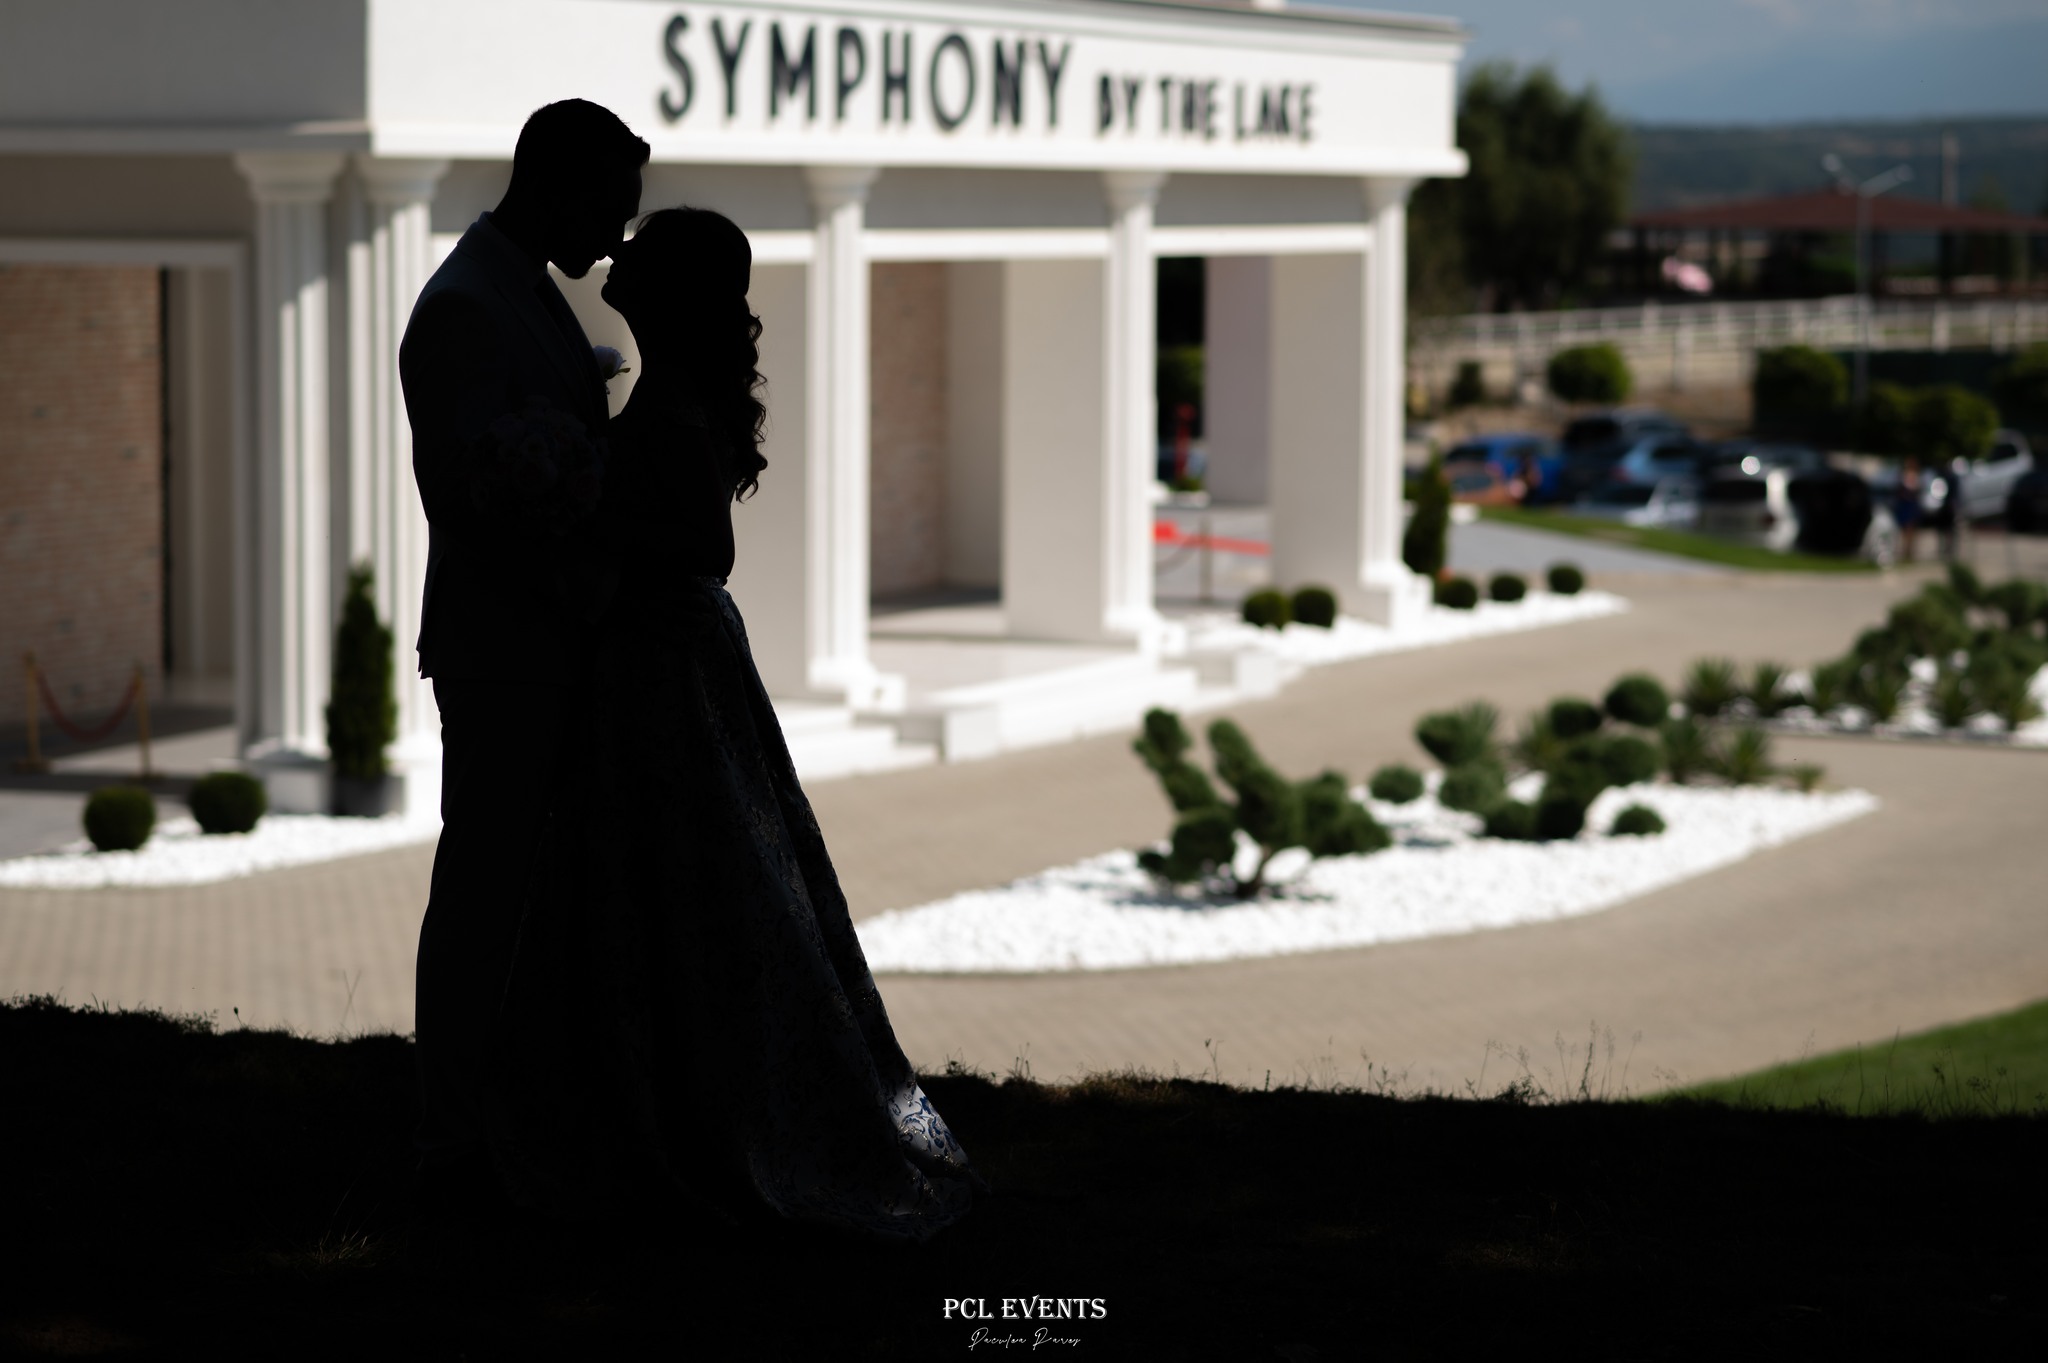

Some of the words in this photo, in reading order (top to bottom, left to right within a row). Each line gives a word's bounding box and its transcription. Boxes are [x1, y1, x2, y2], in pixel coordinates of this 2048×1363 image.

[657, 13, 1070, 131] SYMPHONY
[1096, 73, 1142, 137] BY
[1156, 77, 1218, 142] THE
[1234, 81, 1312, 145] LAKE
